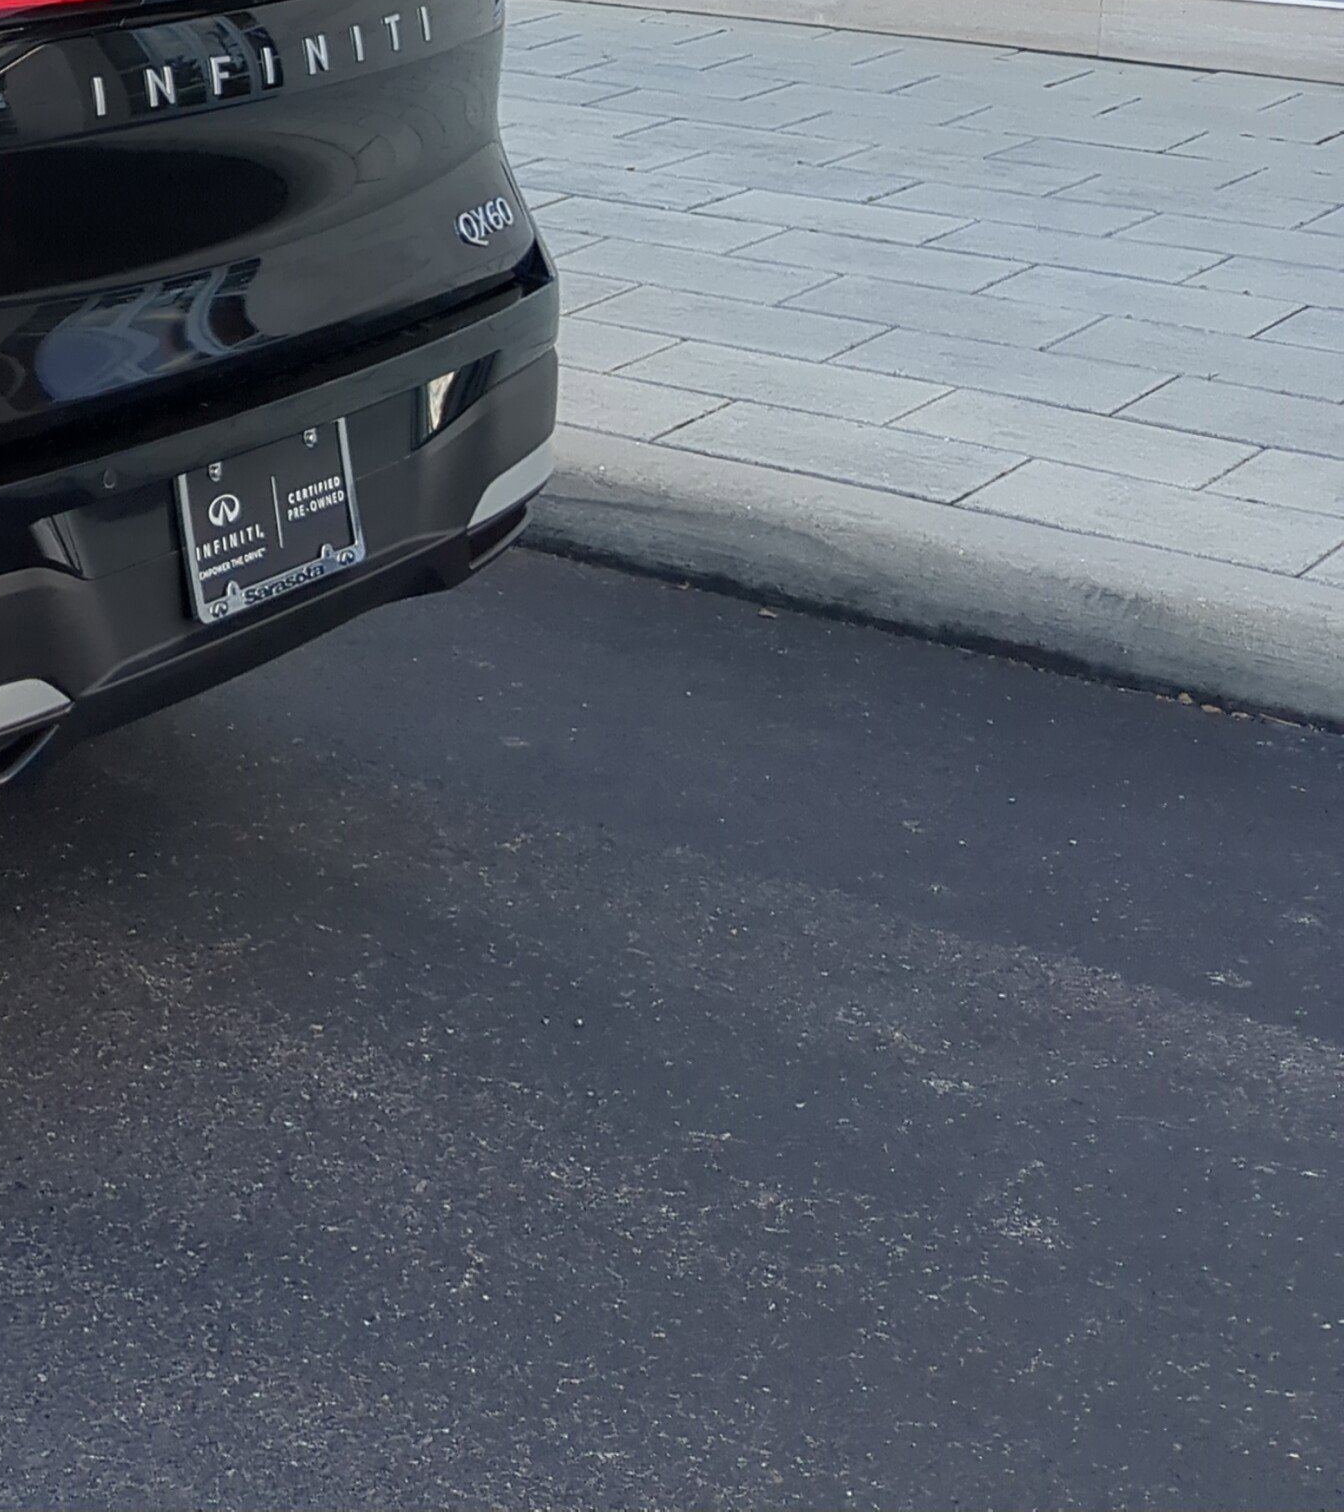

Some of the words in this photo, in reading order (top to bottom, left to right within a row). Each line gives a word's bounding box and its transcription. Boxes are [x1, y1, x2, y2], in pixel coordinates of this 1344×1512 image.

[92, 6, 432, 116] INFINITI
[456, 196, 514, 248] QX60
[287, 476, 341, 505] CERTIFIED
[287, 490, 345, 522] PRE-OWNED
[196, 523, 262, 562] INFINITI
[198, 560, 231, 581] EMPOWER
[230, 555, 245, 569] THE
[243, 564, 325, 605] Sarasota
